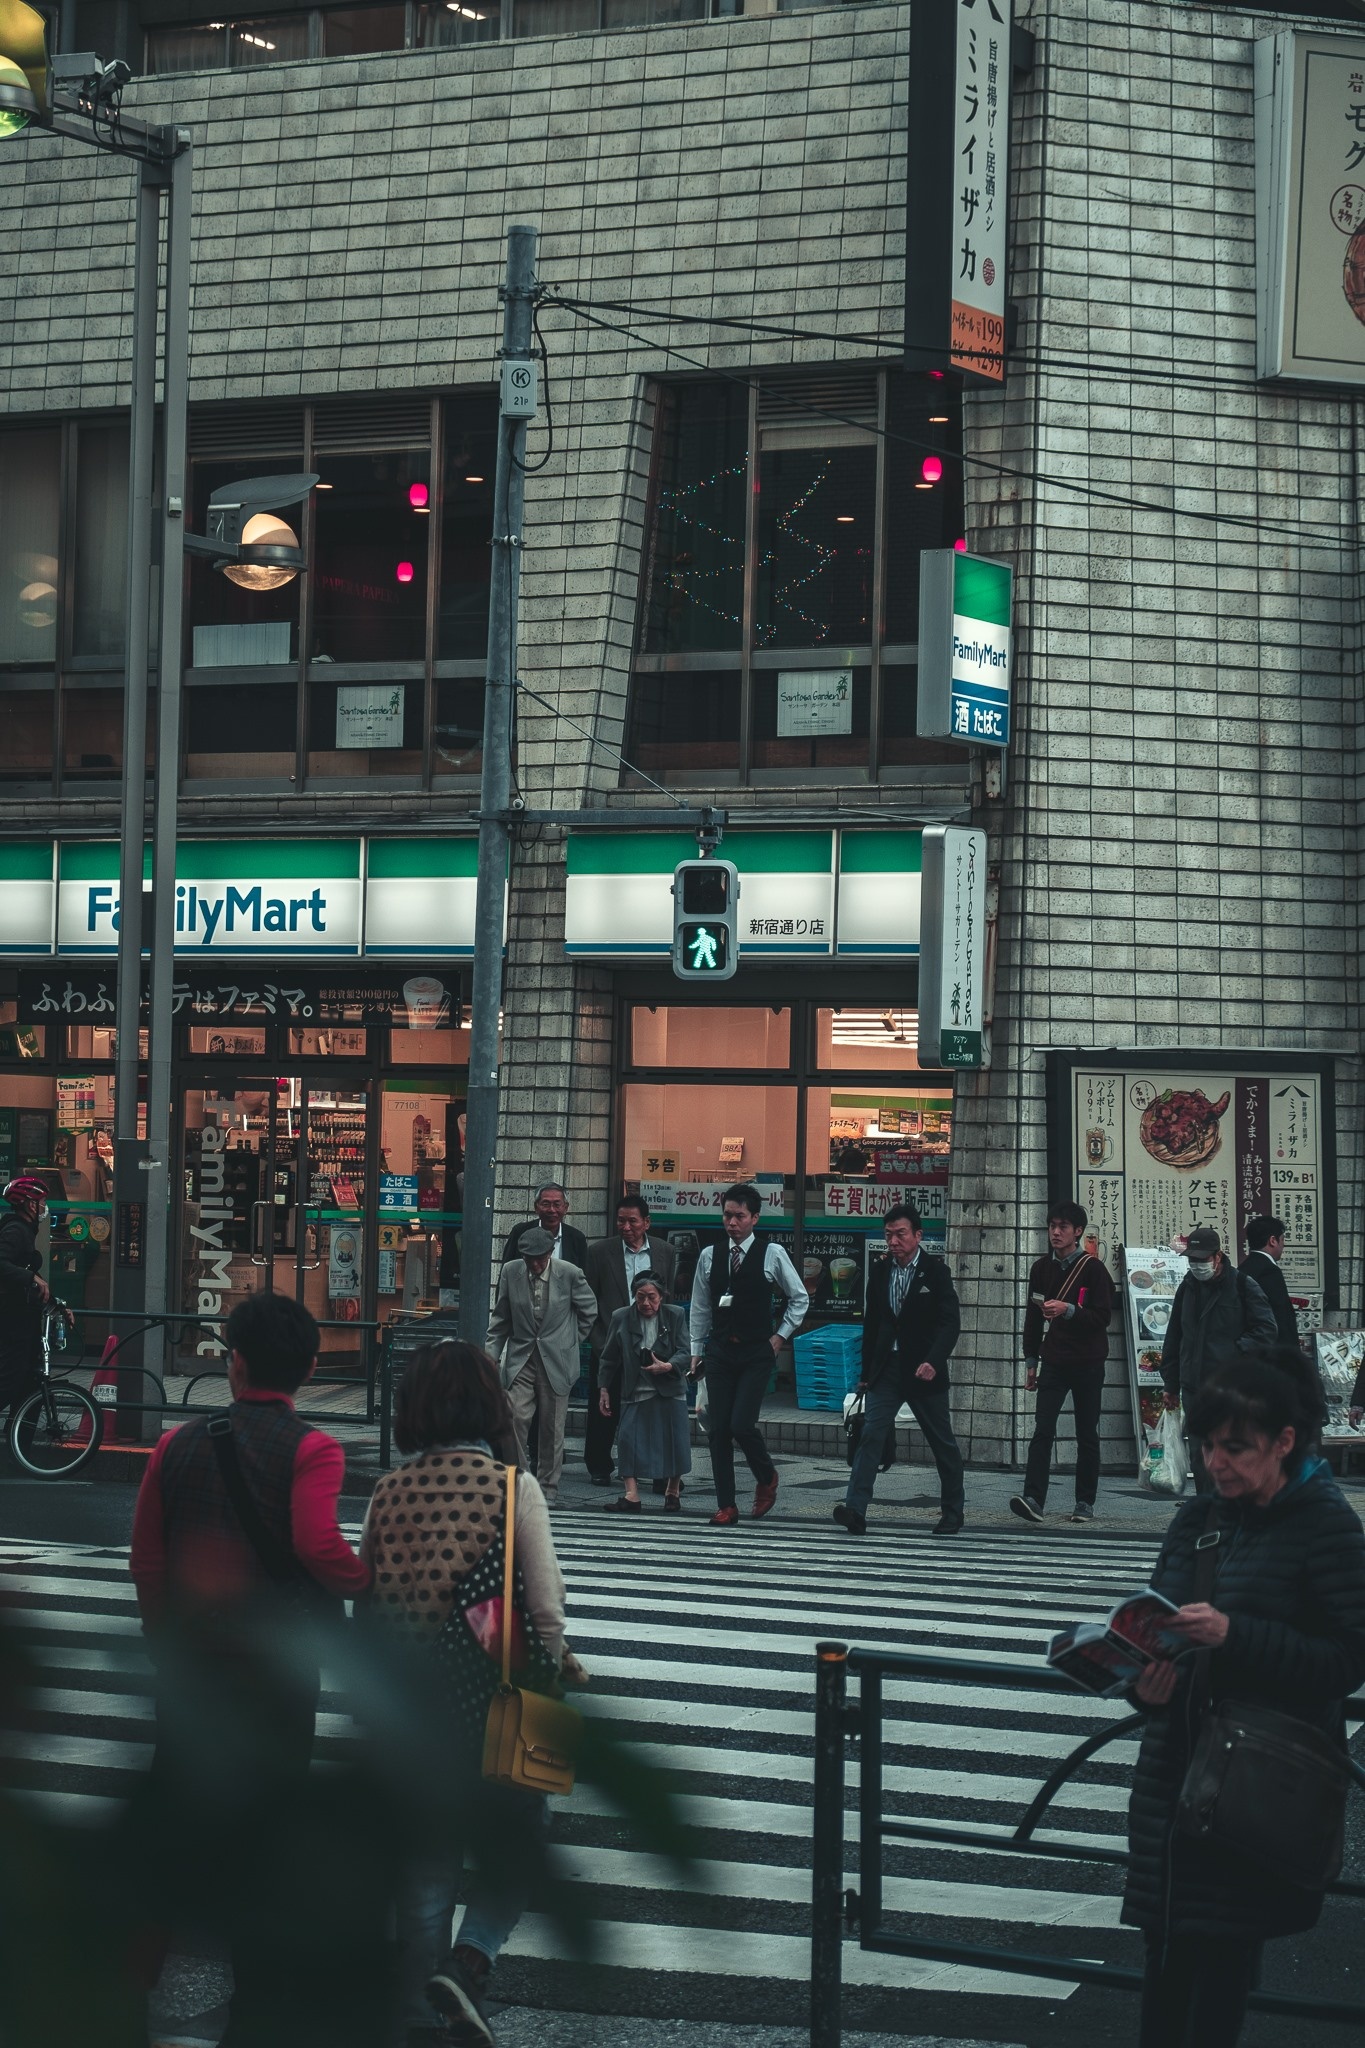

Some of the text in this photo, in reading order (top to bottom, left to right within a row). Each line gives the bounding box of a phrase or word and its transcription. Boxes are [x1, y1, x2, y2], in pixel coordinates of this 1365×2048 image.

[959, 28, 980, 282] ミライザカ
[985, 38, 998, 232] 旨唐揚げと居酒メシ
[1337, 190, 1353, 226] 名物
[953, 636, 1006, 669] FamilyMart
[955, 699, 1003, 737] 酒 たばこ
[87, 886, 326, 945] FilyMart
[749, 918, 825, 936] 新宿通り店
[32, 981, 313, 1018] ふわふテはファミマ。
[319, 988, 400, 1001] 総投資額200億円の
[58, 1081, 94, 1090] Famiポート
[394, 1101, 420, 1110] 77108
[1096, 1080, 1106, 1124] ハイボール
[1107, 1079, 1116, 1127] ジムビーム
[1246, 1085, 1259, 1151] でかうま!
[1287, 1098, 1299, 1159] ミライザカ
[385, 1176, 412, 1187] たばこ
[646, 1158, 676, 1173] 予告
[1241, 1153, 1254, 1210] 清流若鶏の
[1253, 1154, 1263, 1198] みちのく
[1301, 1173, 1314, 1184] B1
[675, 1190, 710, 1207] おでん
[1099, 1179, 1110, 1228] 香るエール
[1294, 1194, 1304, 1242] 予約受付中
[1304, 1194, 1313, 1242] 各種ご宴会
[190, 1099, 236, 1357] FamilyMart
[1110, 1179, 1121, 1272] ザ・プレミアム・モルツ
